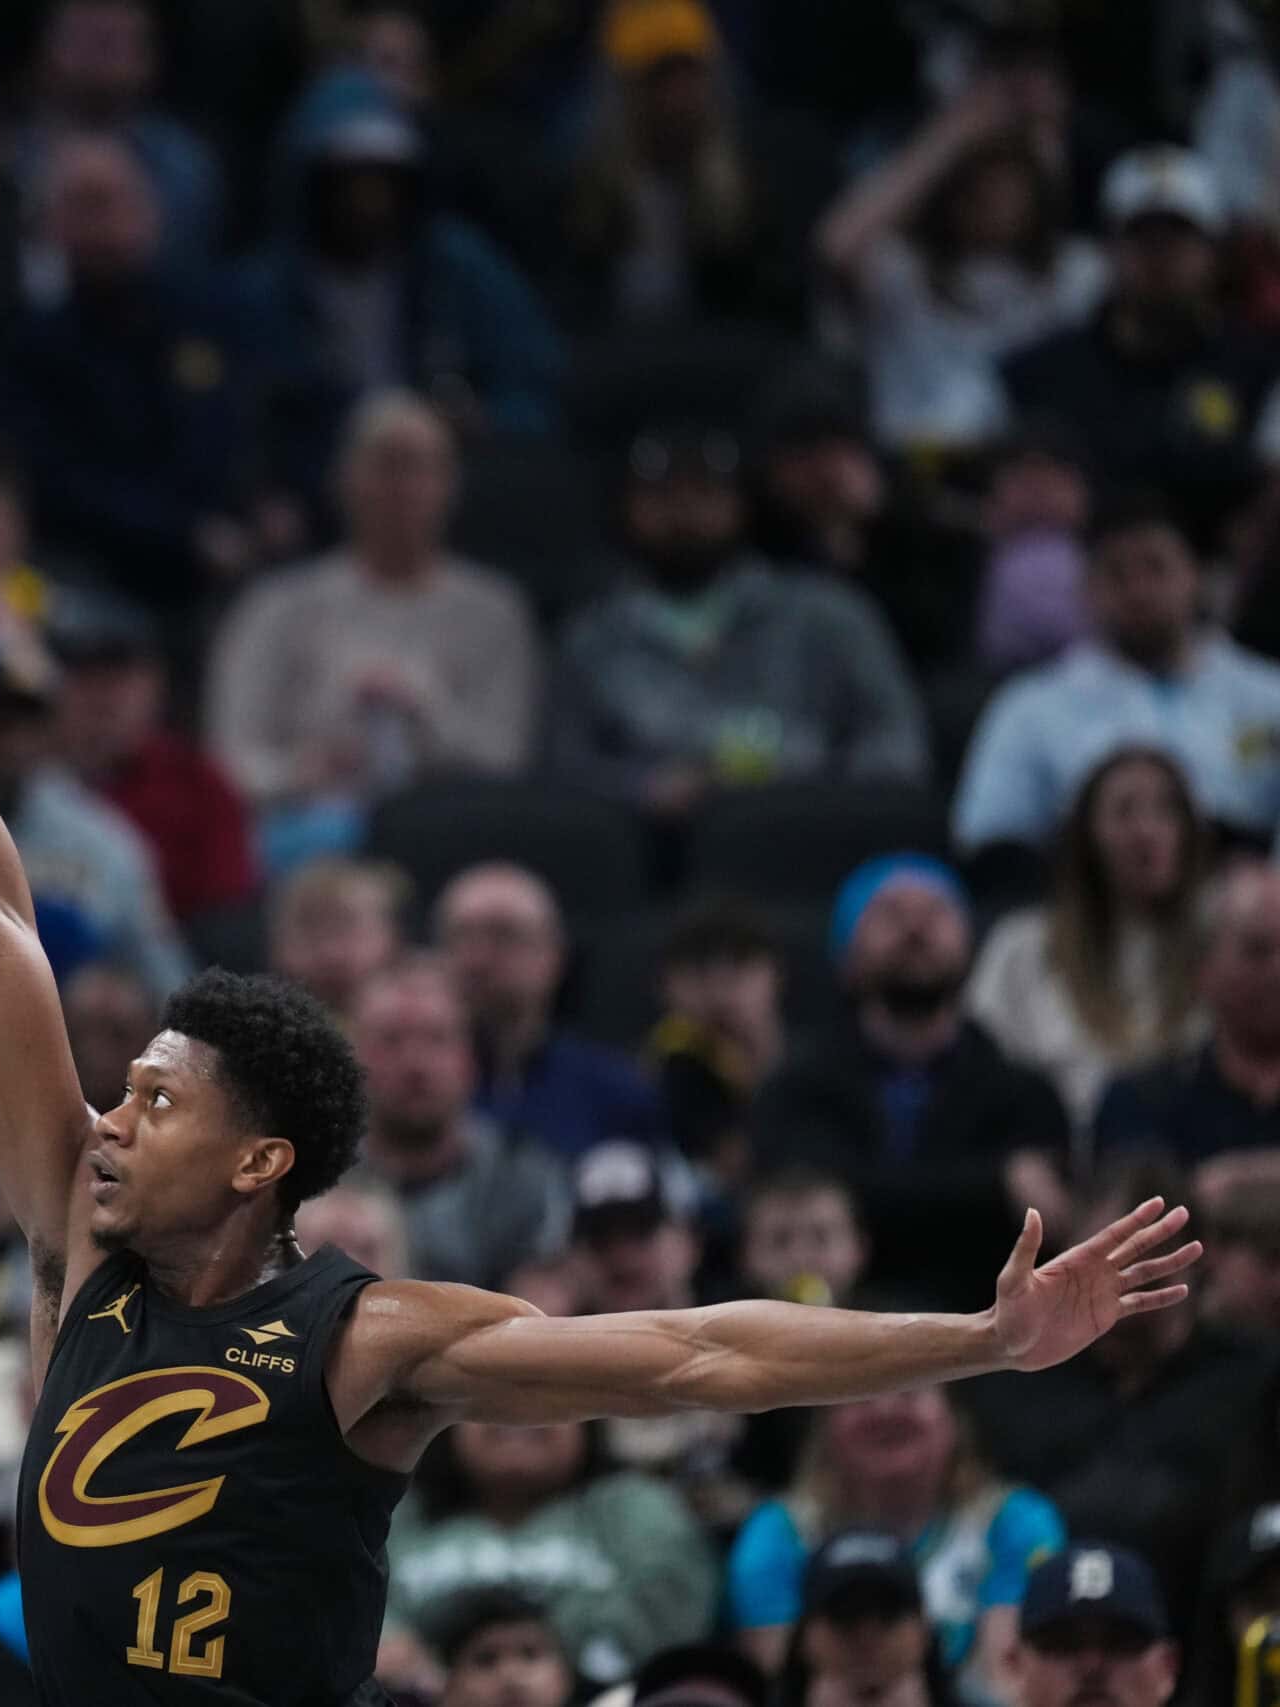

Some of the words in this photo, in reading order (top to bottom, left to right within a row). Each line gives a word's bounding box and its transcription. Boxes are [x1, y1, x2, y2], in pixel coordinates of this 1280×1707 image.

[225, 1347, 296, 1374] CLIFFS
[38, 1365, 271, 1548] C
[126, 1566, 232, 1678] 12
